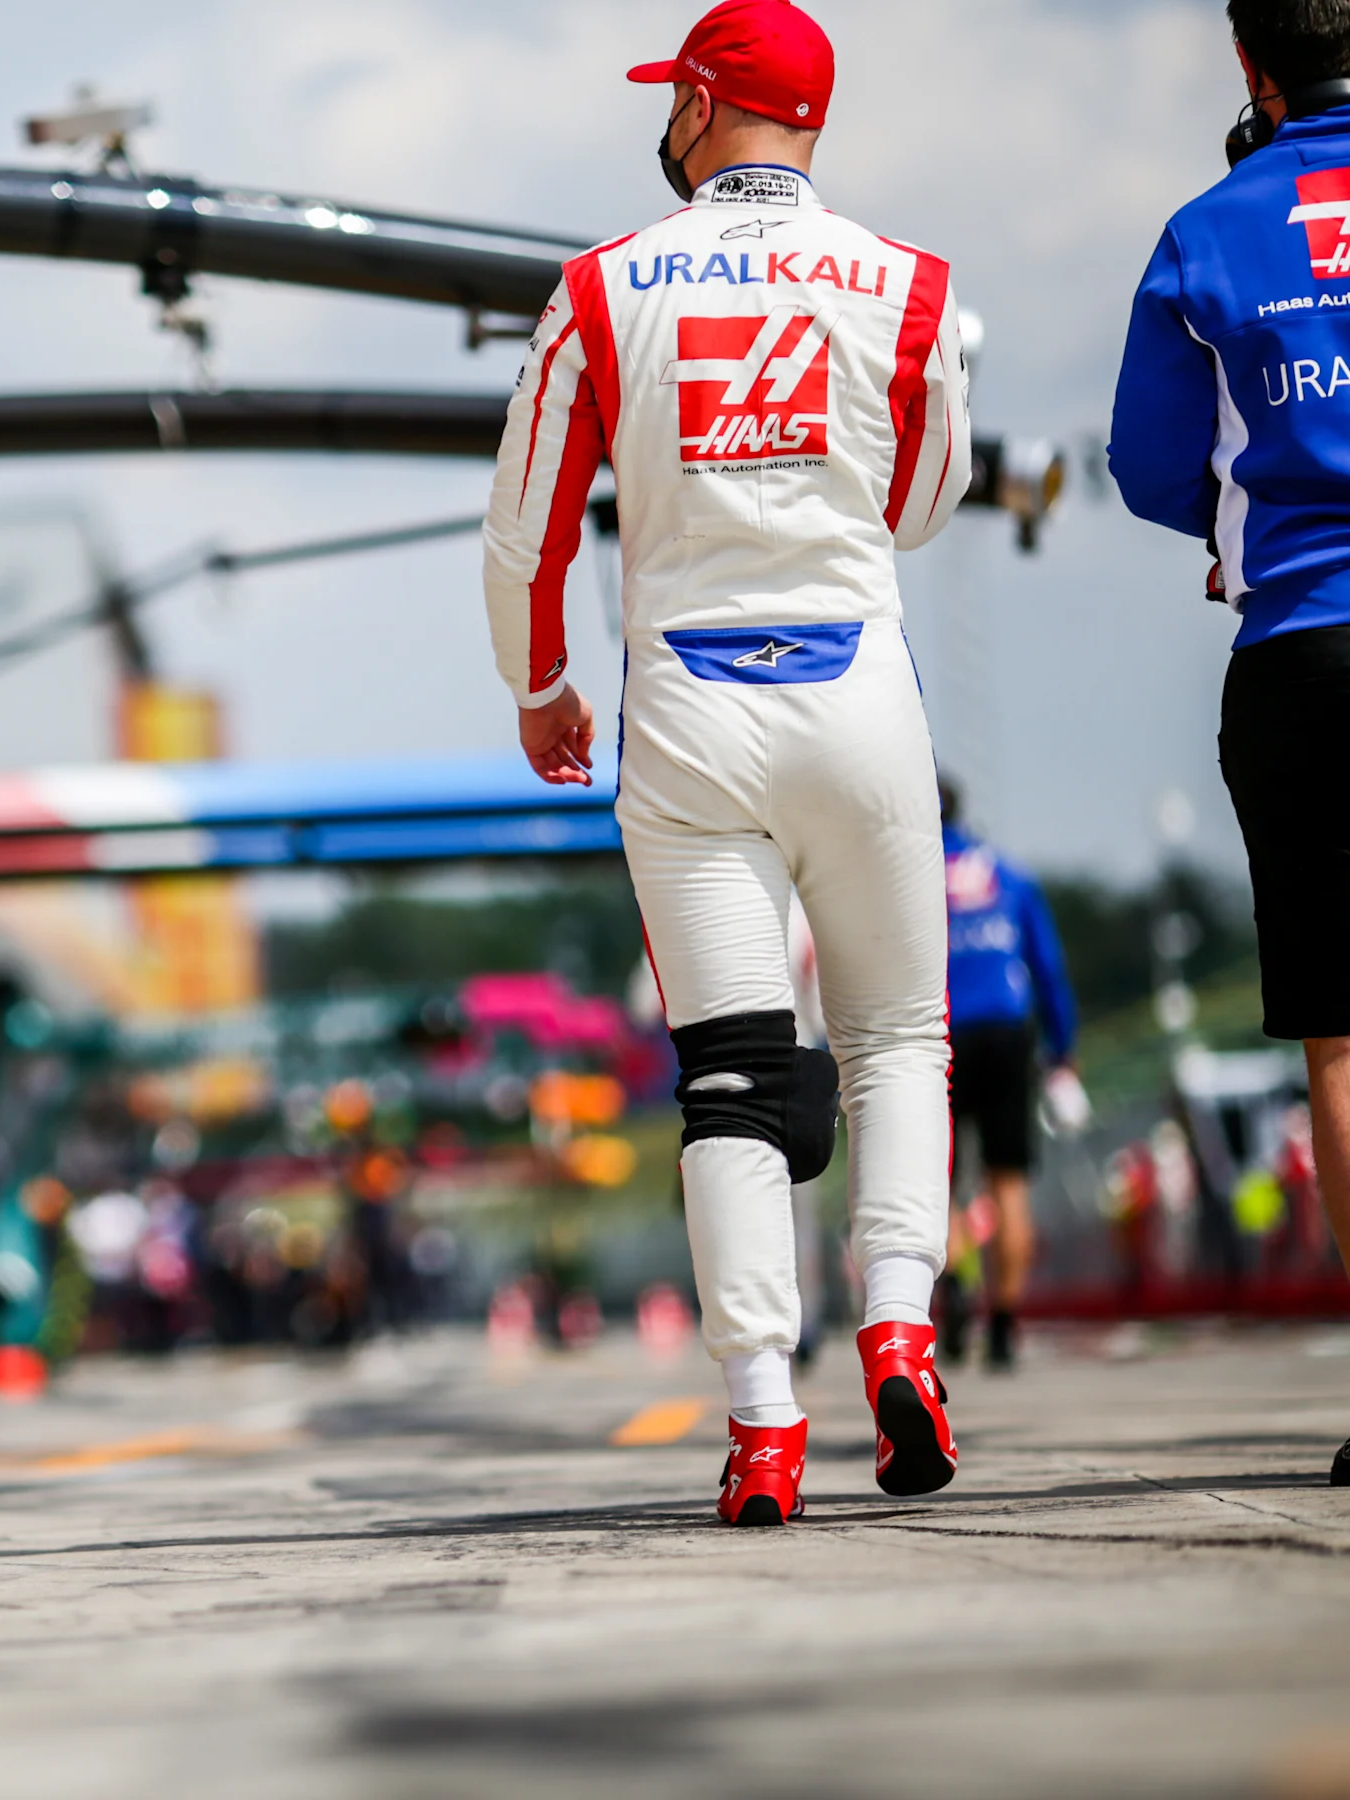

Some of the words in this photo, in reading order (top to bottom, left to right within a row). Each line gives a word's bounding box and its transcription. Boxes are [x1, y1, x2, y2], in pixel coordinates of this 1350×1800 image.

[685, 56, 717, 81] URALKALI
[628, 252, 887, 297] URALKALI
[1258, 297, 1314, 317] Haas
[1262, 355, 1350, 406] URA
[680, 413, 827, 454] HAAS
[682, 466, 716, 475] Haas
[720, 461, 800, 473] Automation
[804, 459, 829, 467] Inc.
